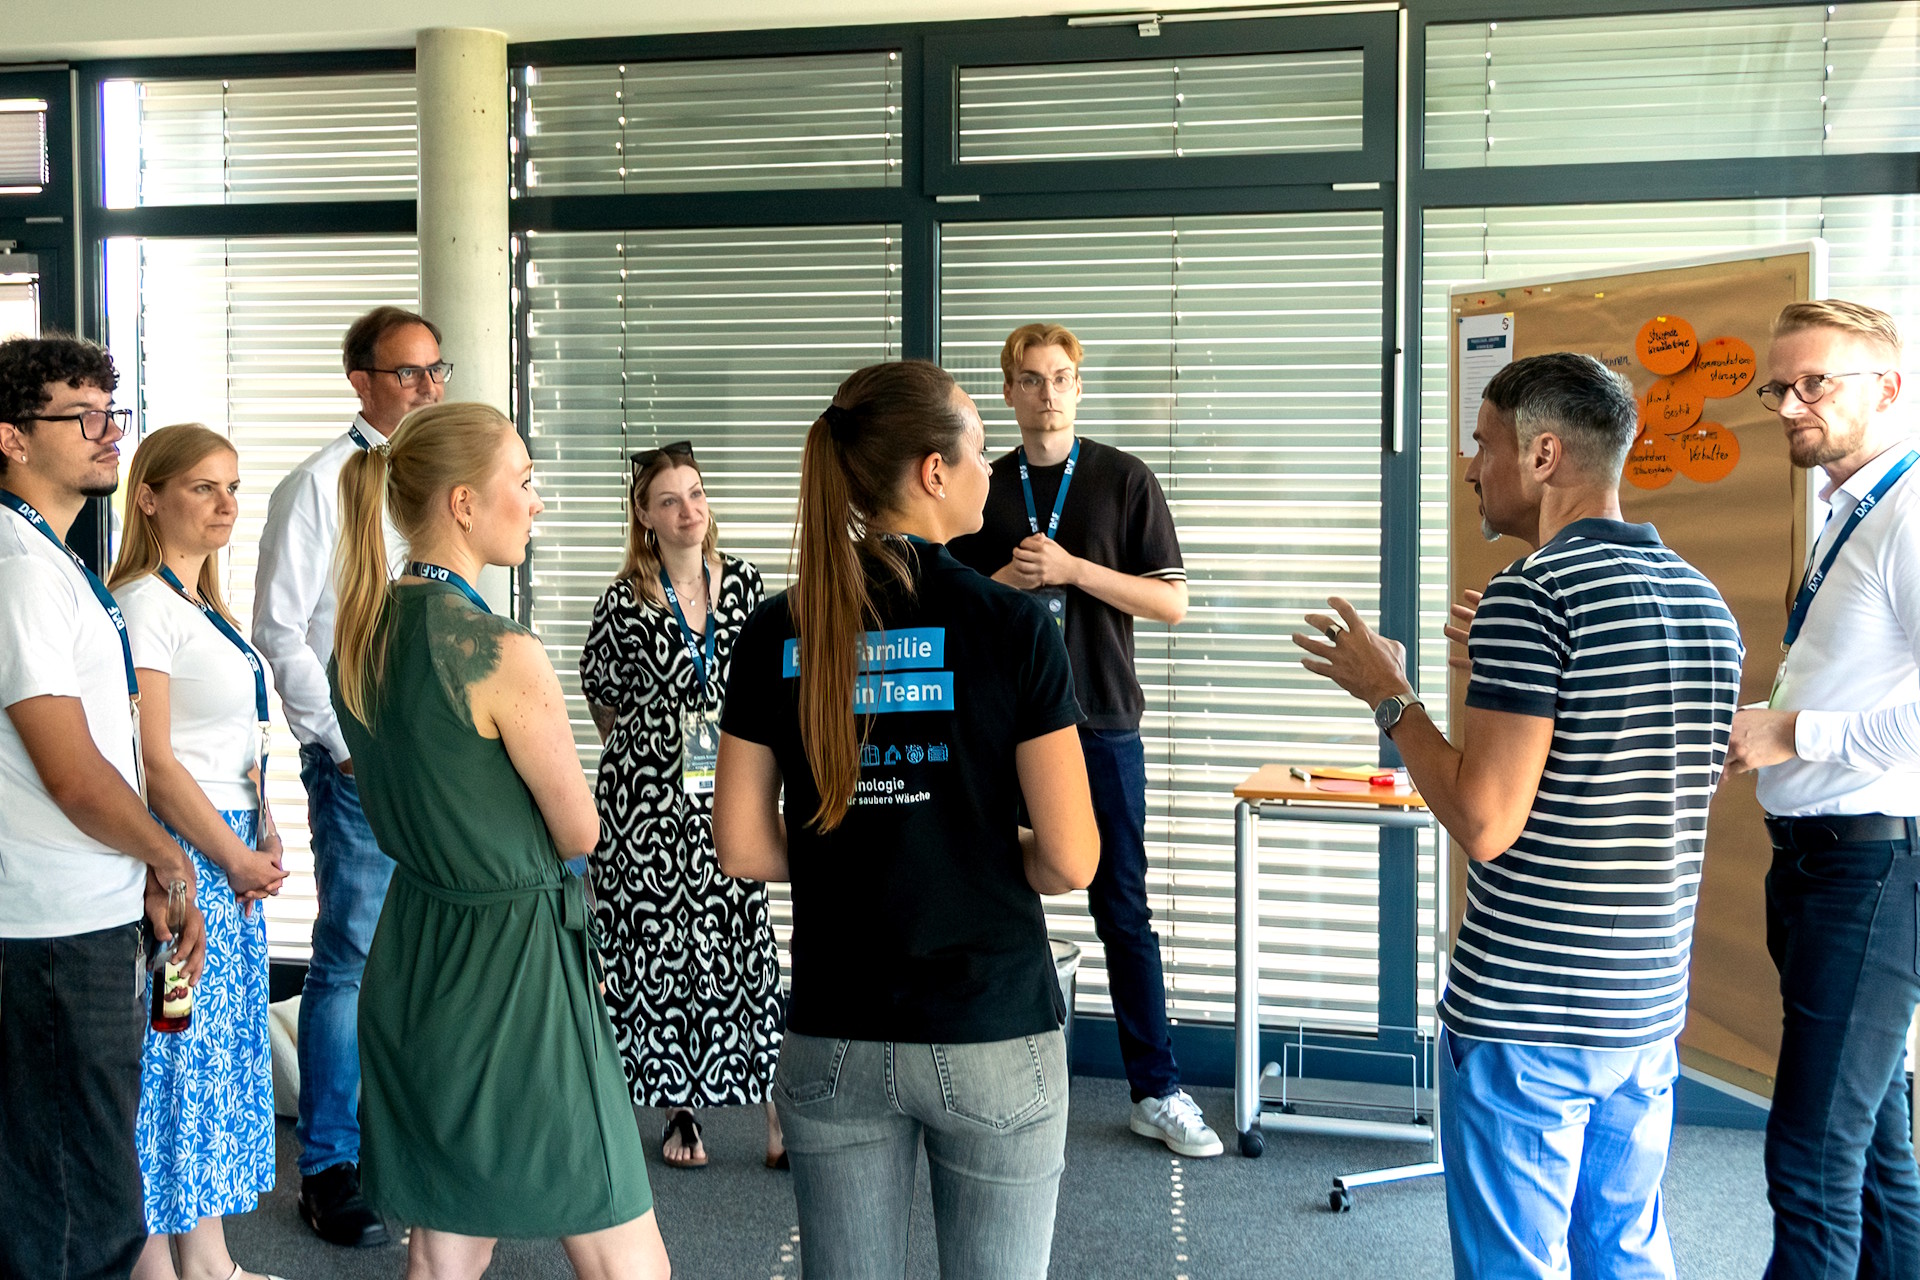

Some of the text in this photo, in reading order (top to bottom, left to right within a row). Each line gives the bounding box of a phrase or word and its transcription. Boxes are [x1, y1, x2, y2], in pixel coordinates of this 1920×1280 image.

[18, 503, 44, 525] DAF
[1855, 493, 1877, 519] DAF
[421, 564, 449, 582] DAF
[1807, 568, 1824, 593] DAF
[882, 681, 943, 703] Team
